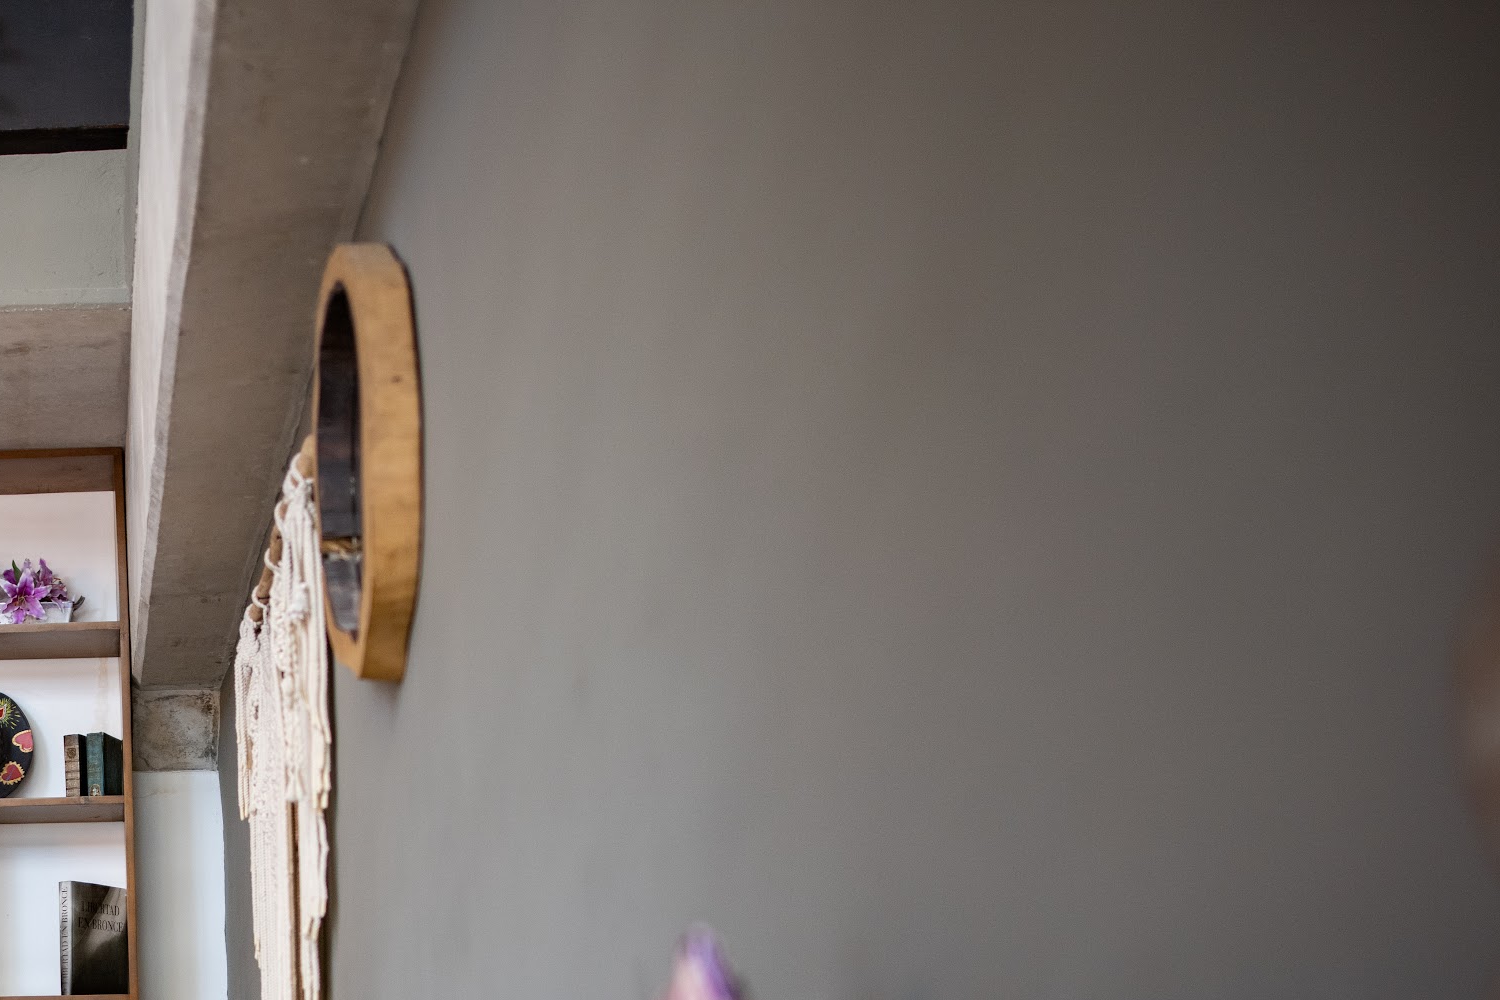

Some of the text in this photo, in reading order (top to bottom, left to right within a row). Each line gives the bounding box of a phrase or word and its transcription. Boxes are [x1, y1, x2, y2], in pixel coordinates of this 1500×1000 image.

[81, 901, 120, 916] LIBERTAD
[78, 917, 124, 933] EN BRONCE
